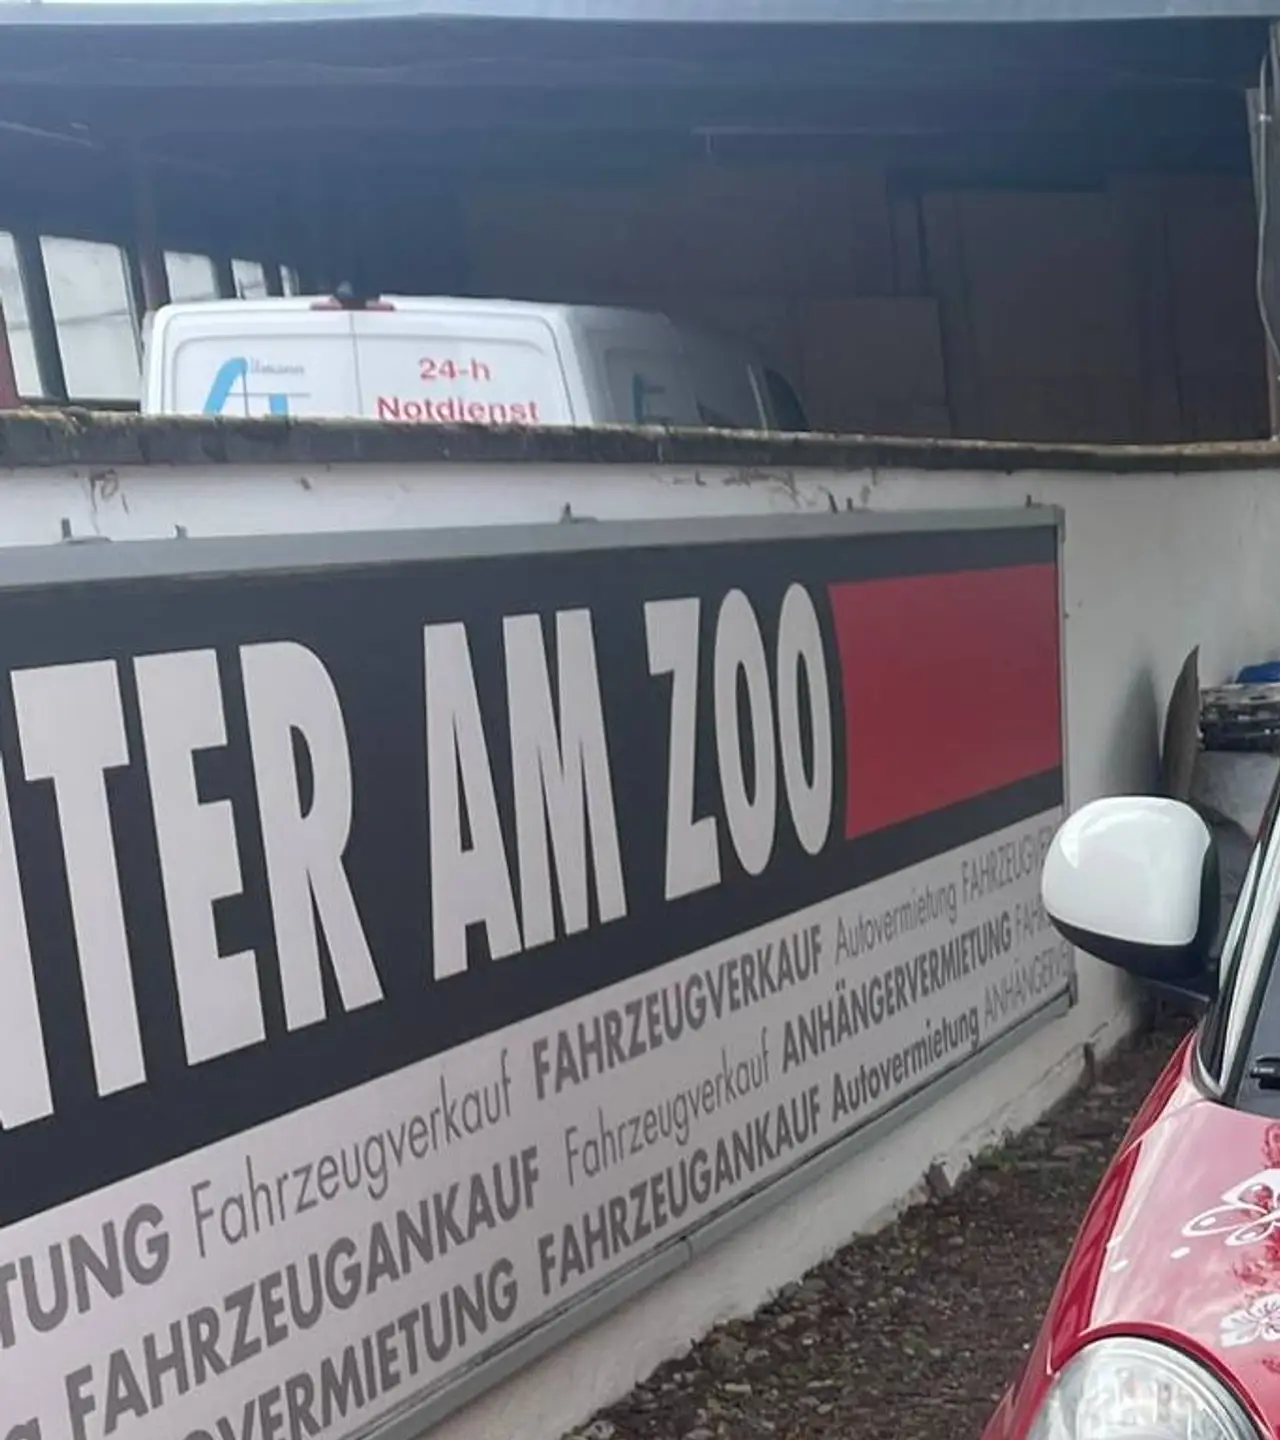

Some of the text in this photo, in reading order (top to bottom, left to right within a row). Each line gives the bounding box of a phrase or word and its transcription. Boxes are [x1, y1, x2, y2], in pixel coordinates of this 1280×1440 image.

[377, 396, 539, 422] Notdienst
[418, 357, 491, 381] 24-h
[423, 607, 628, 981] AM
[643, 582, 834, 901] ZOO
[190, 1047, 513, 1259] Fahrzeugverkauf
[533, 924, 822, 1100] FAHRZEUGVERKAUF
[834, 880, 958, 966] Autovermietung
[537, 1085, 821, 1296] FAHRZEUGANKAUF
[832, 1006, 979, 1123] Autovermietung
[564, 1026, 771, 1187] Fahrzeugverkauf
[781, 911, 1012, 1074] ANHÄNGERVERMIETUNG
